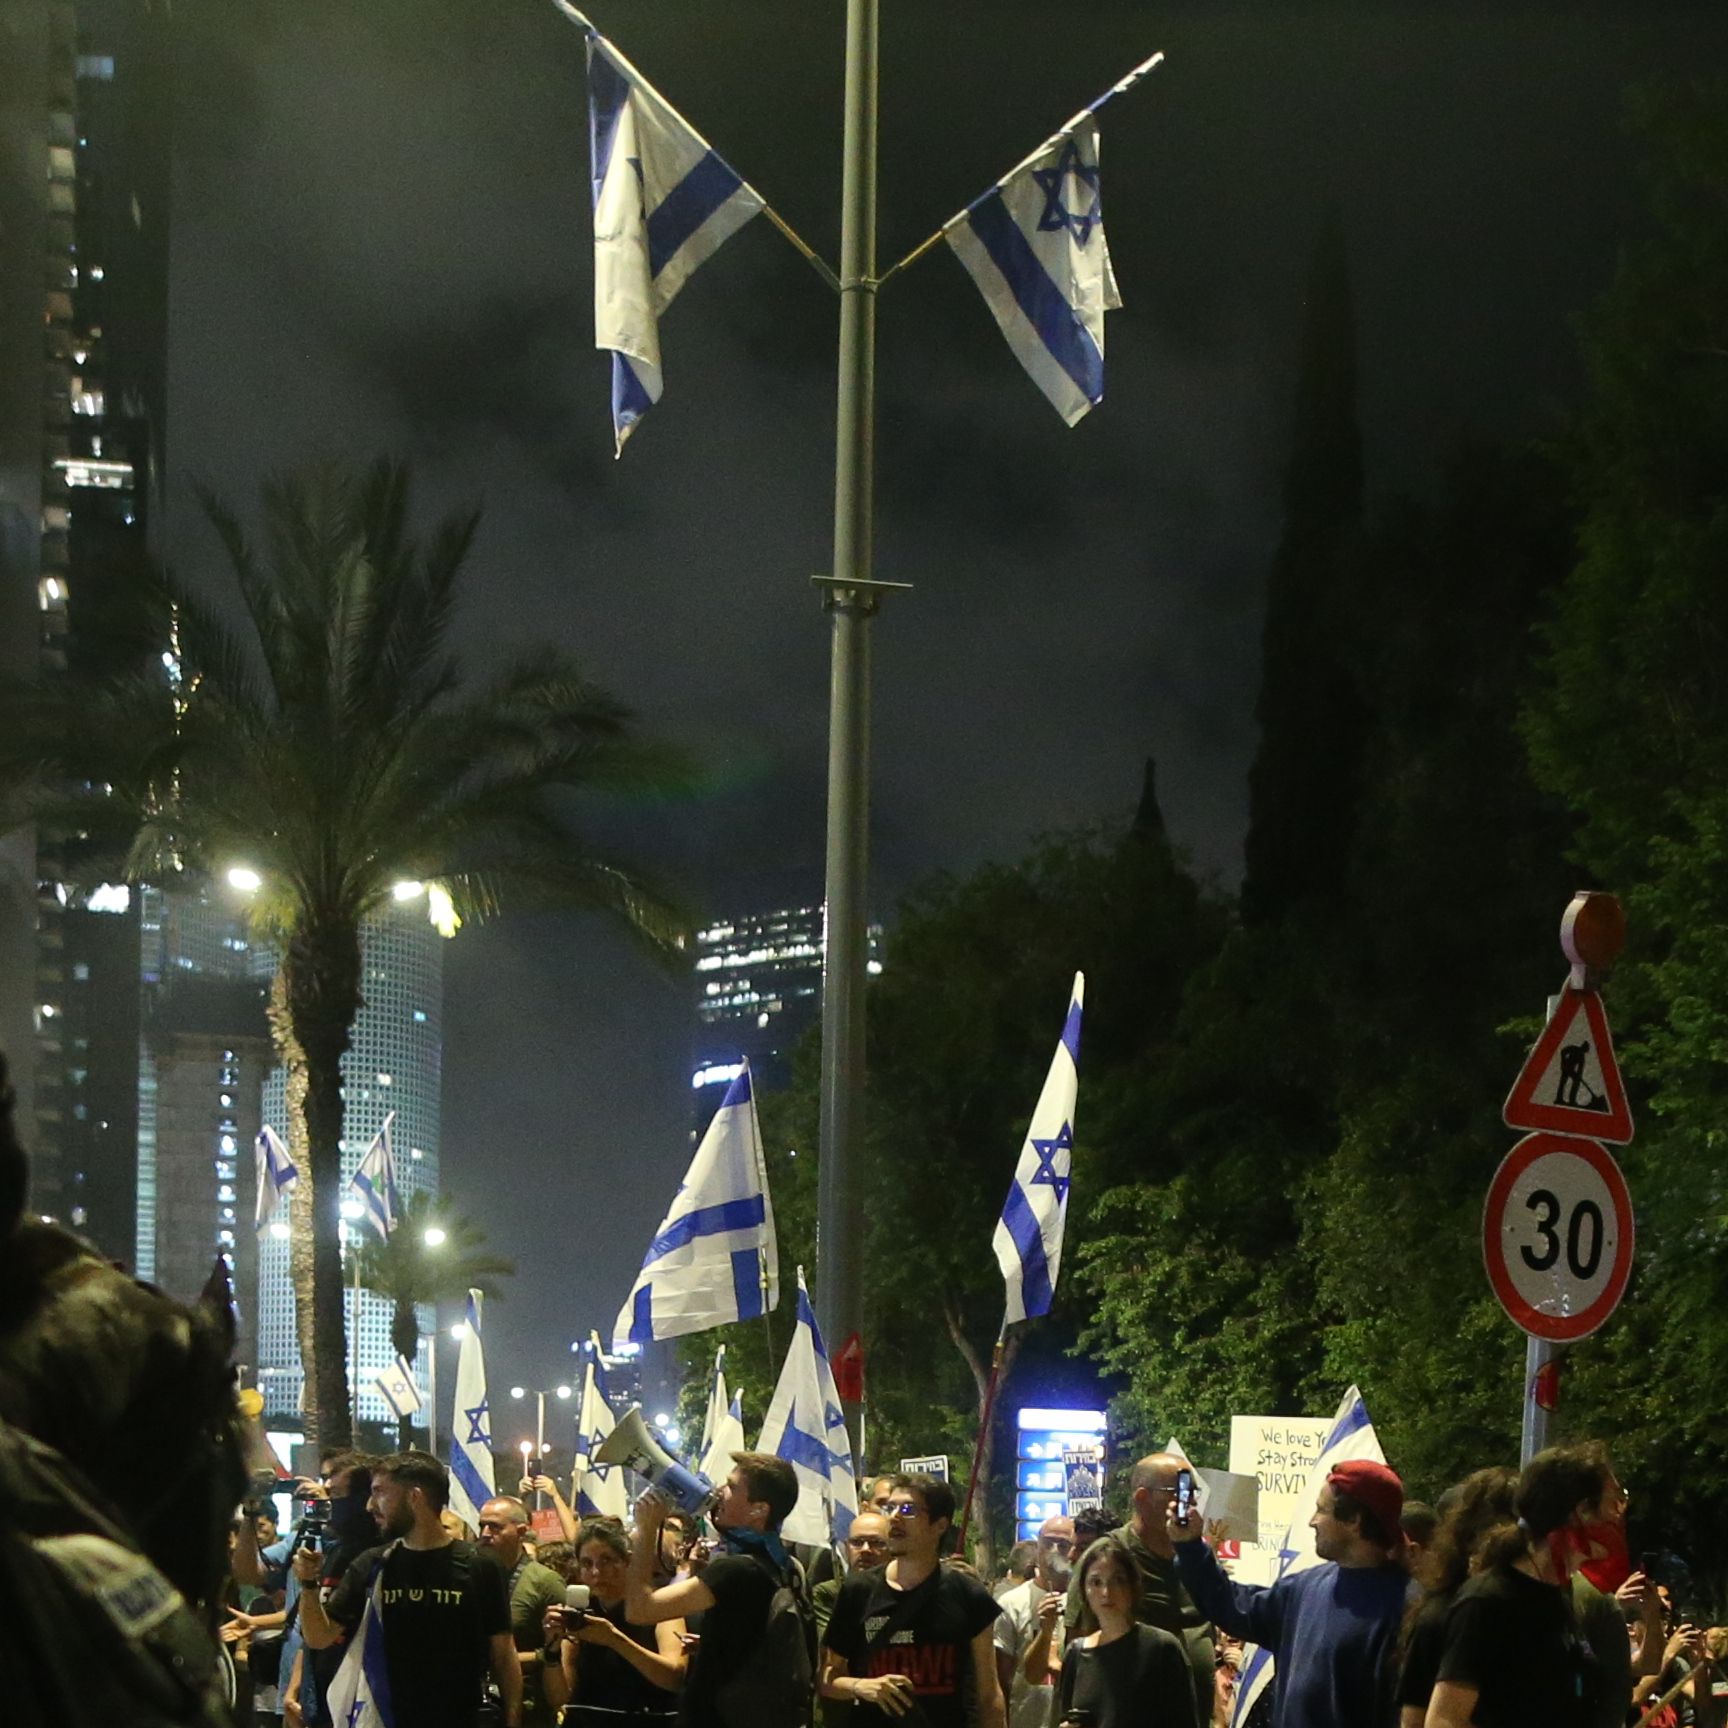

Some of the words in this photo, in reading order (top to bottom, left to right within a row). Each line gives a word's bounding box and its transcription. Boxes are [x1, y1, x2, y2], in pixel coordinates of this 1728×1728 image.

[1519, 1188, 1604, 1281] 30
[1261, 1427, 1282, 1444] We
[1286, 1429, 1312, 1448] love
[1257, 1448, 1288, 1471] Stay
[1290, 1451, 1318, 1468] Stro
[432, 1589, 462, 1604] דור
